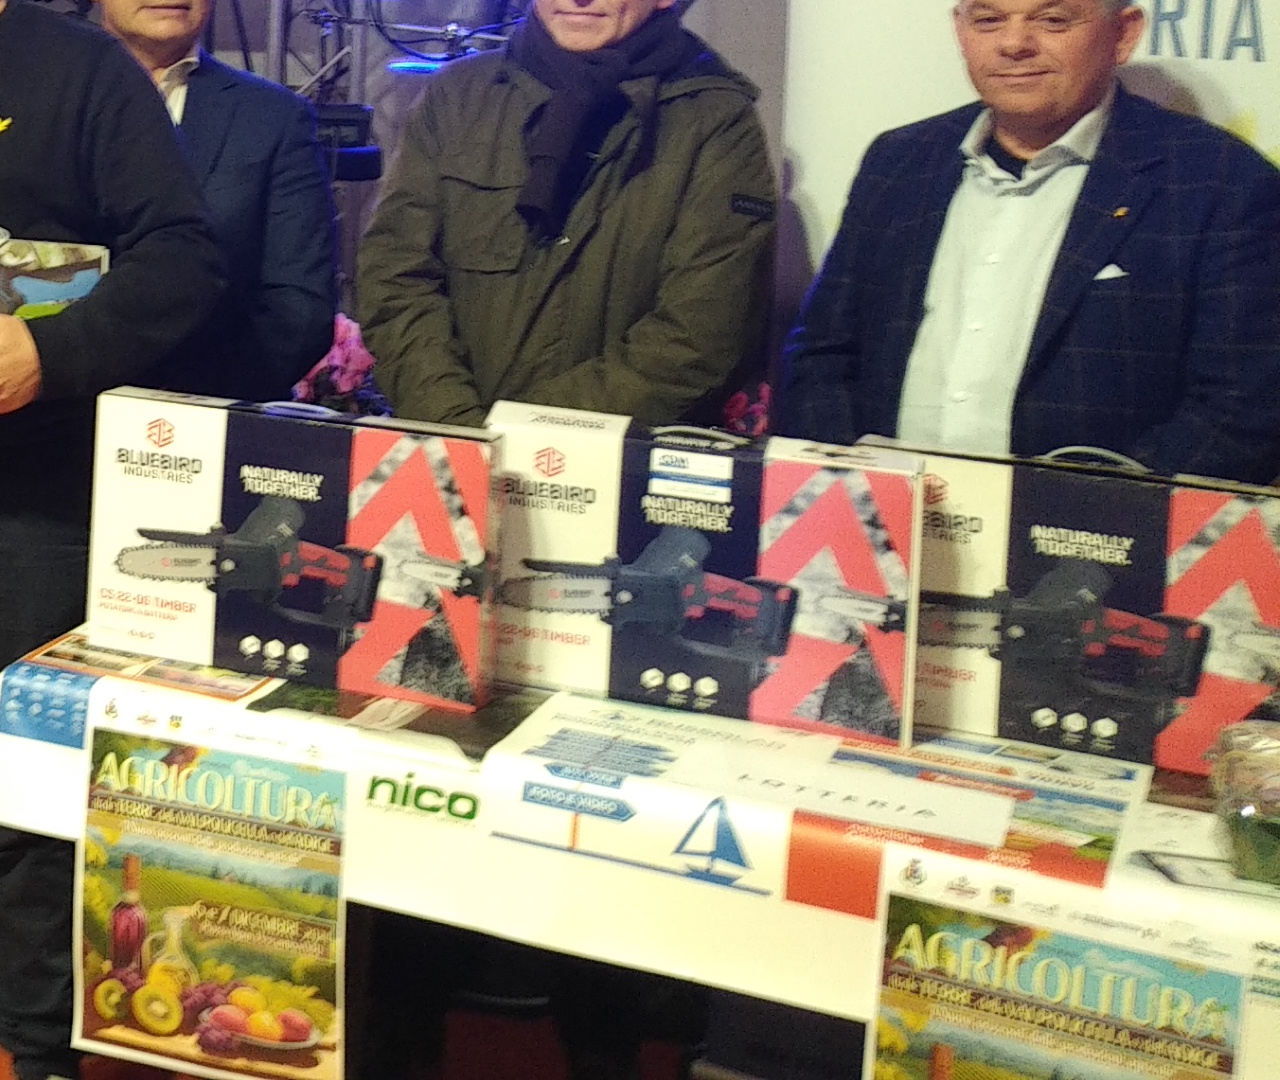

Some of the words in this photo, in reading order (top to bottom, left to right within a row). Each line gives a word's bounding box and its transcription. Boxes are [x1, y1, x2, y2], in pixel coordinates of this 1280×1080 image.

[116, 448, 202, 474] BLUEBIRD
[123, 466, 194, 484] INDUSTRIES
[240, 464, 324, 487] NATURALLY
[243, 478, 322, 501] TOGETHER.
[503, 477, 597, 504] BLUEBIRD
[509, 497, 586, 514] INDUSTRIES
[641, 495, 734, 518] NATURALLY
[645, 509, 733, 533] TOGETHER.
[1031, 524, 1135, 550] NATURALLY
[1034, 539, 1133, 566] TOGETHER.
[155, 595, 197, 613] TIMBER
[542, 628, 591, 646] TIMBER
[96, 751, 338, 831] AGRICOLTURA
[366, 772, 480, 820] nico
[892, 922, 1229, 1045] AGRICOLTURA
